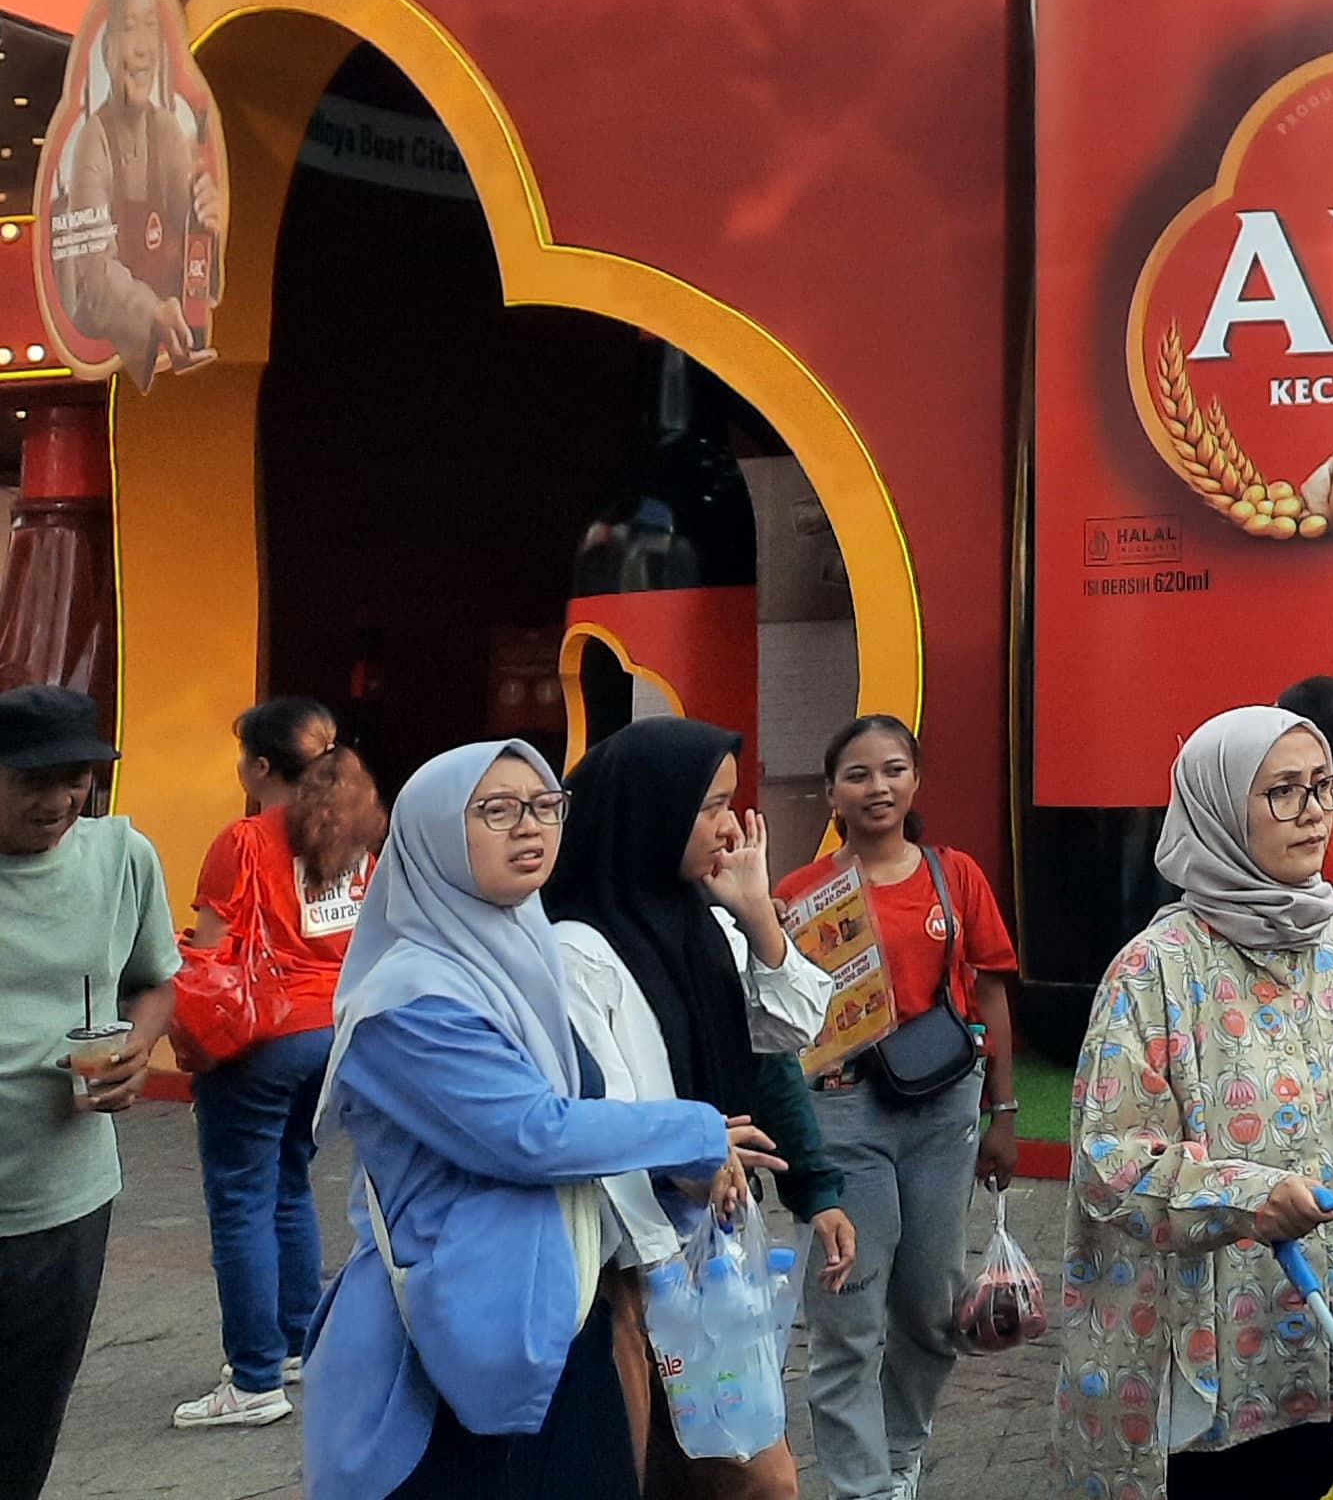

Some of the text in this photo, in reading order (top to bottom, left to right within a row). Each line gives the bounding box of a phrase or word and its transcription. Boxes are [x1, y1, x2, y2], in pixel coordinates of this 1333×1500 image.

[1117, 525, 1177, 544] HALAL
[1102, 577, 1150, 596] BERSIH
[1153, 568, 1211, 593] 620ml
